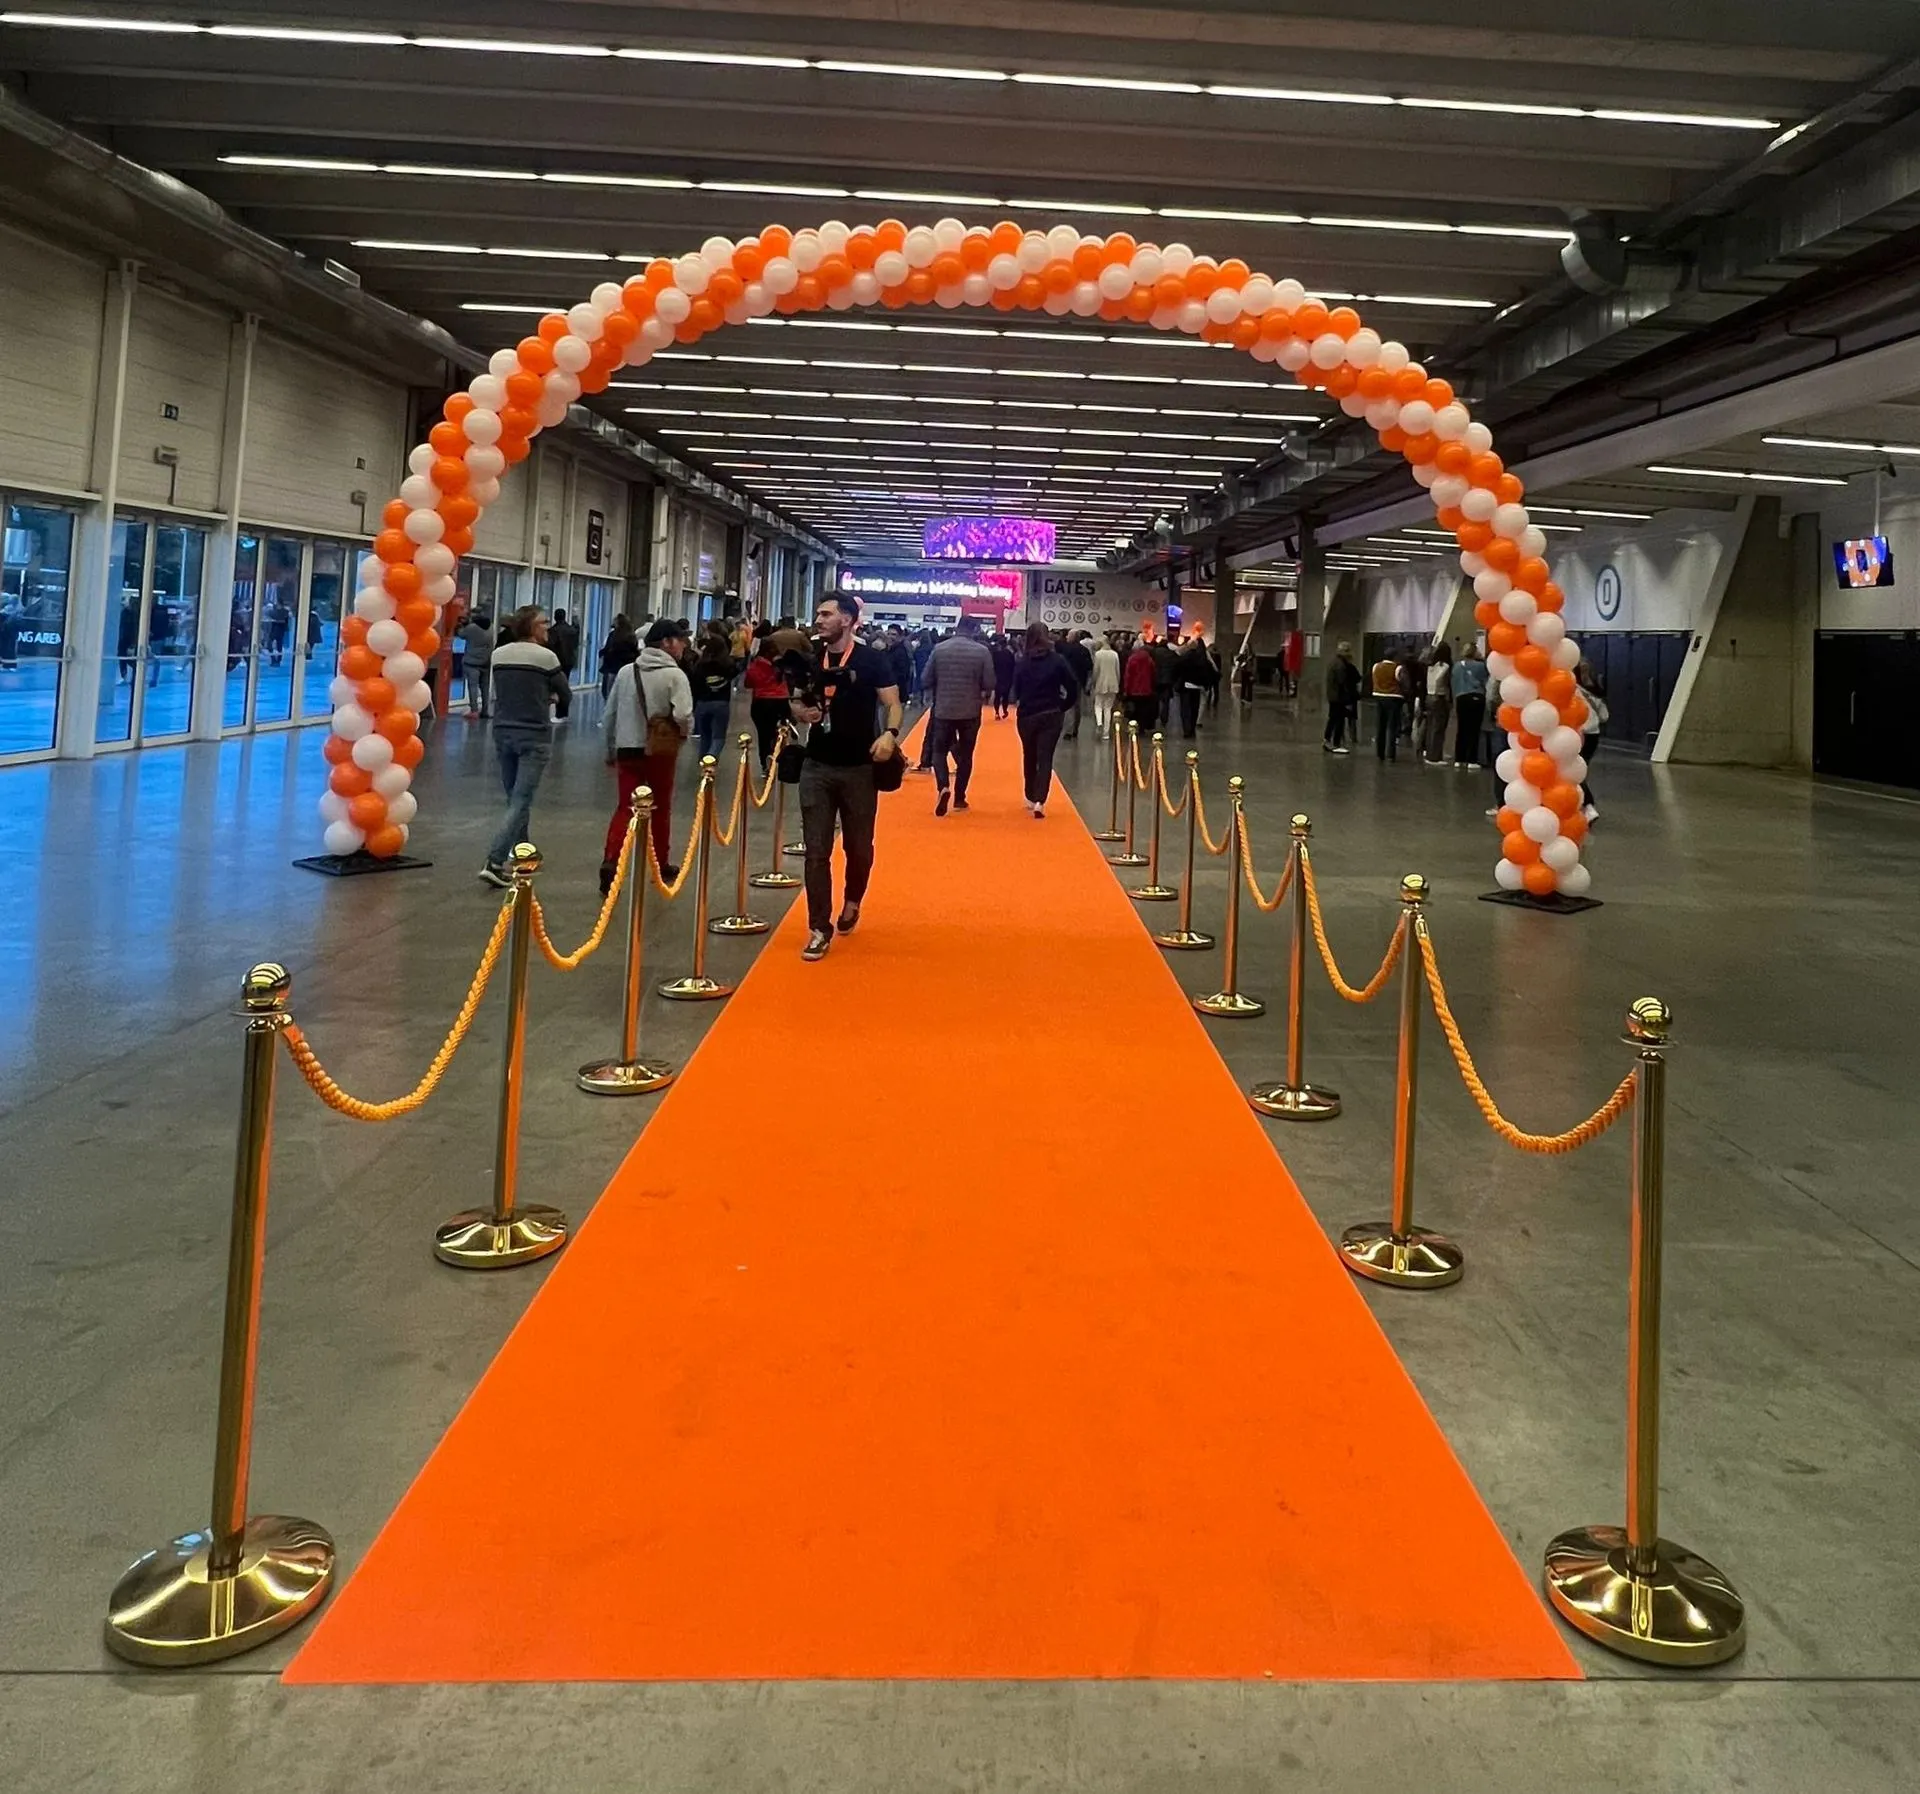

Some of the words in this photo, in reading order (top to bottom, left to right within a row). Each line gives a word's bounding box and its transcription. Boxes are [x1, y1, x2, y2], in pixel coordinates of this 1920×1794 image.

[929, 581, 977, 598] birthday
[979, 584, 1012, 600] today
[1044, 579, 1096, 595] GATES
